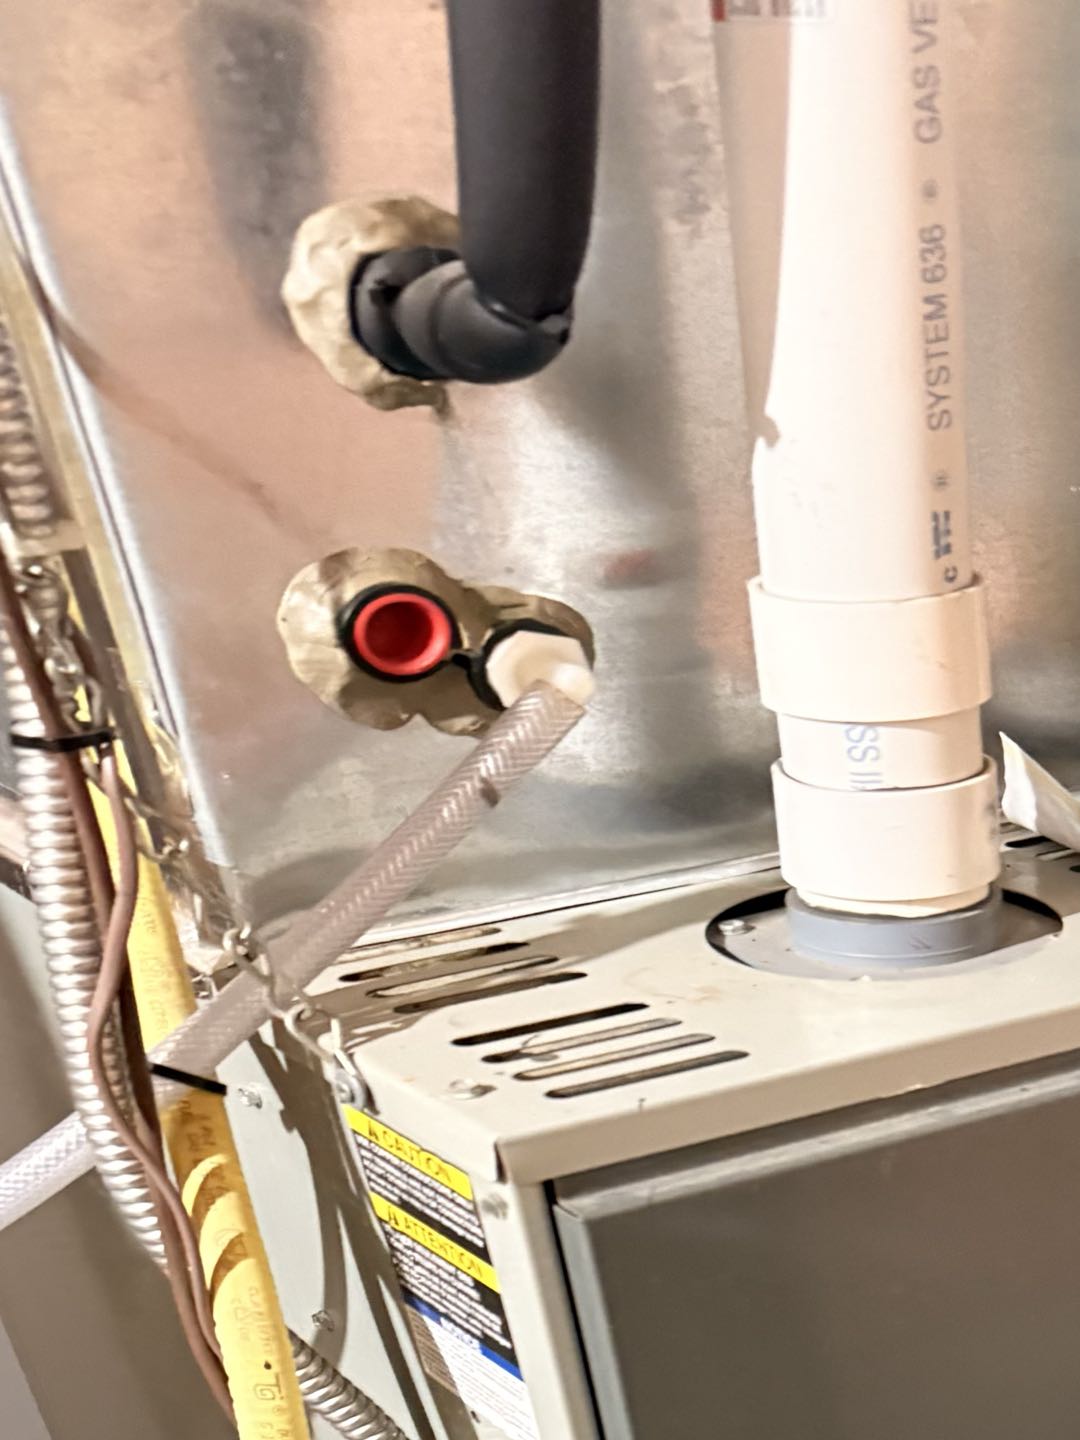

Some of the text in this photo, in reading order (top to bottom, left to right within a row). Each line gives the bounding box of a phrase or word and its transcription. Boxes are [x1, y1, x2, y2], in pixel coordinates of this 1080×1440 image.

[912, 65, 942, 144] GAS
[917, 224, 947, 283] 636
[922, 294, 952, 431] SYSTEM
[404, 1220, 482, 1277] ATTENTION
